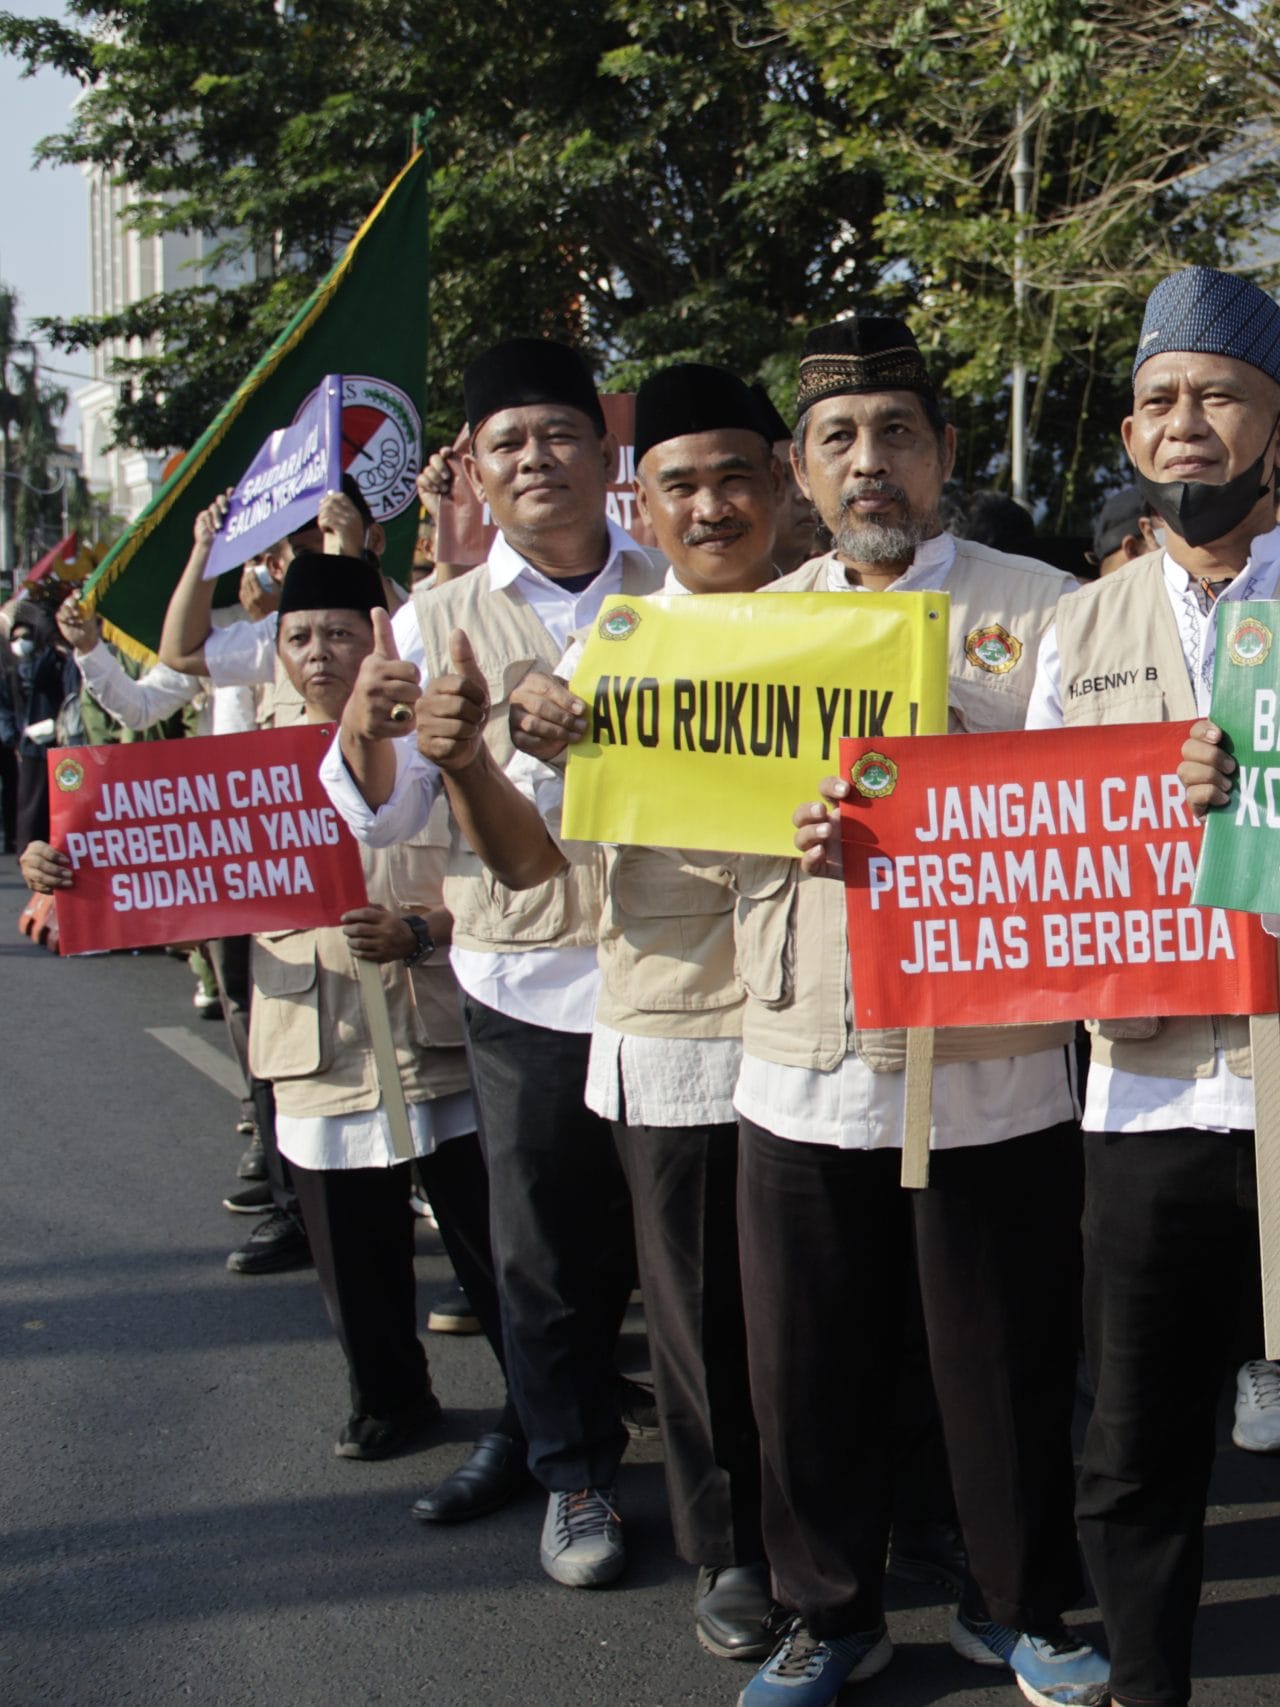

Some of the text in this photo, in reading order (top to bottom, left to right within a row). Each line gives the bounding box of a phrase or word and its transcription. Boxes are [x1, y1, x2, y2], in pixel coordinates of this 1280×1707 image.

[225, 448, 327, 542] SALING MENJAGA
[1145, 666, 1158, 681] B
[593, 675, 660, 747] AYO
[674, 678, 800, 759] RUKUN
[816, 687, 894, 760] YUK
[95, 774, 220, 821] JANGAN
[226, 764, 303, 808] CARI
[915, 775, 1200, 842] JANGAN CAR
[66, 807, 339, 869] PERBEDAAN YANG
[111, 856, 314, 912] SUDAH SAMA
[868, 841, 1196, 910] PERSAMAAN YA
[901, 908, 1235, 974] JELAS BERBEDA
